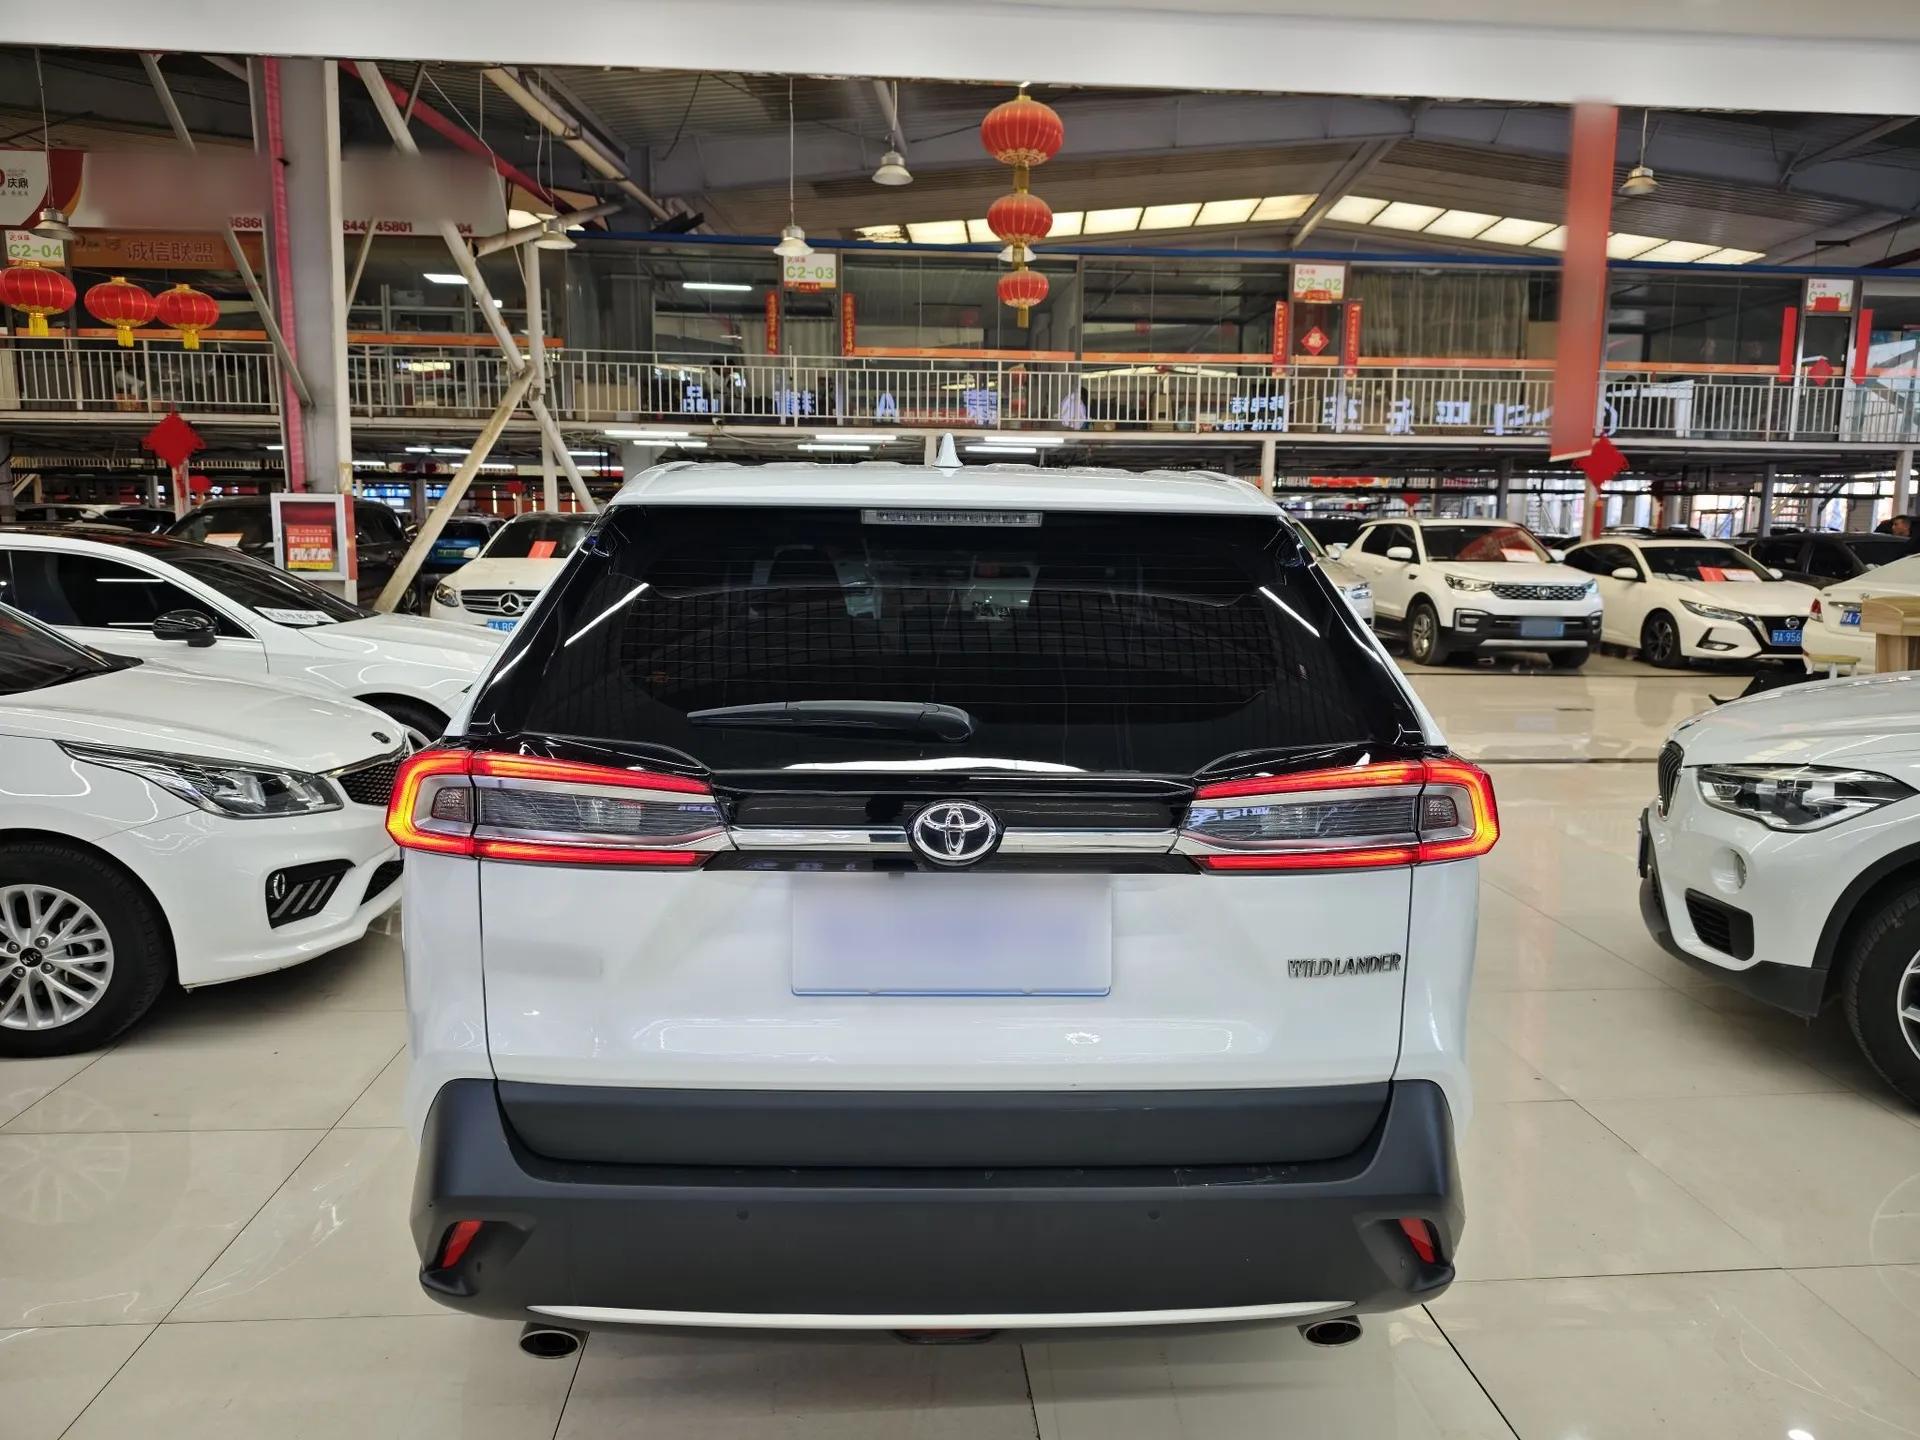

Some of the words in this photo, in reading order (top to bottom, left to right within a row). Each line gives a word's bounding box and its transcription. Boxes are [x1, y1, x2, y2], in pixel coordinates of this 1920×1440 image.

[9, 244, 62, 258] C2-04
[128, 241, 215, 262] 诚信联盟
[786, 265, 834, 279] C2-03
[1296, 277, 1341, 290] C2-02
[22, 951, 41, 965] KIA
[1287, 953, 1402, 978] WILDLANDER
